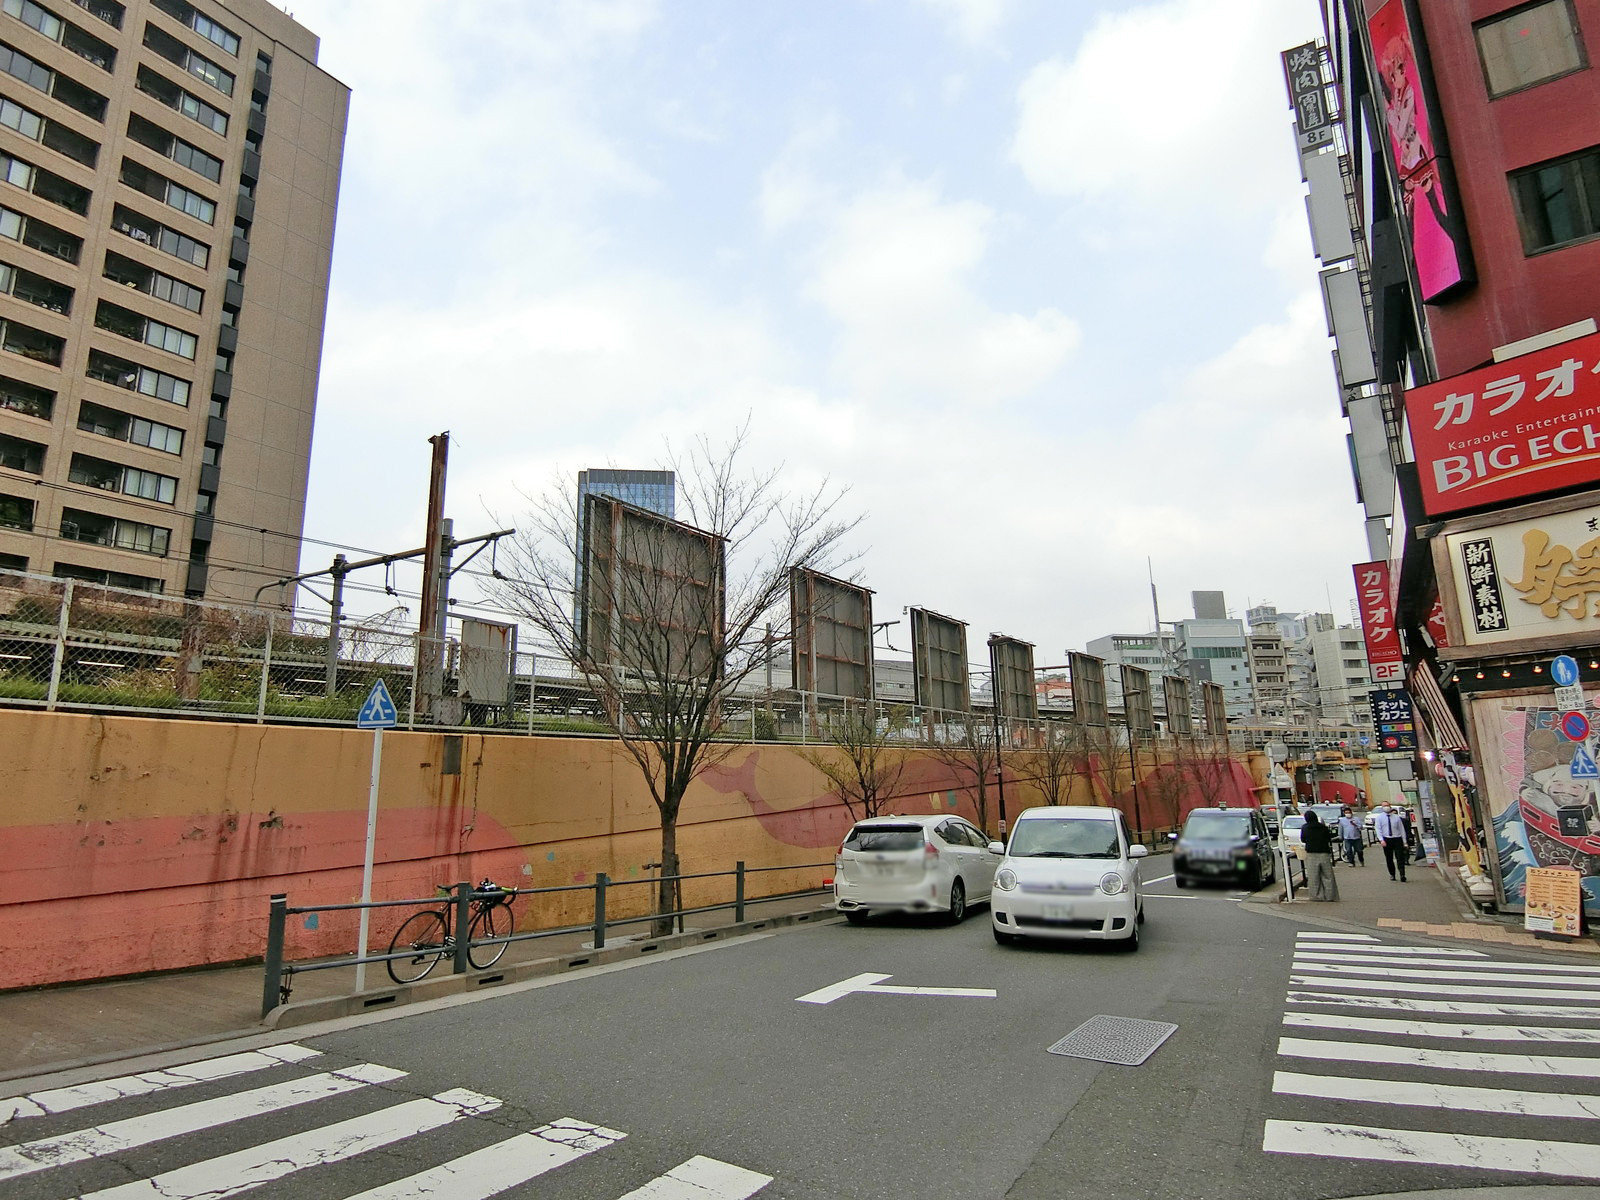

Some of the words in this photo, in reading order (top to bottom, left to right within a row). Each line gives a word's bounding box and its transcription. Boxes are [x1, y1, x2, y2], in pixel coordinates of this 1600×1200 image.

[1290, 48, 1319, 92] 焼肉
[1307, 131, 1325, 143] 8F
[1433, 358, 1600, 431] カラオ
[1448, 429, 1509, 451] Karaoke
[1432, 444, 1520, 493] BIG
[1465, 543, 1503, 628] 新鮮素材
[1362, 570, 1392, 643] カラオケ
[1376, 664, 1399, 678] 2F
[1378, 700, 1408, 710] ネット
[1380, 711, 1410, 720] カフェ
